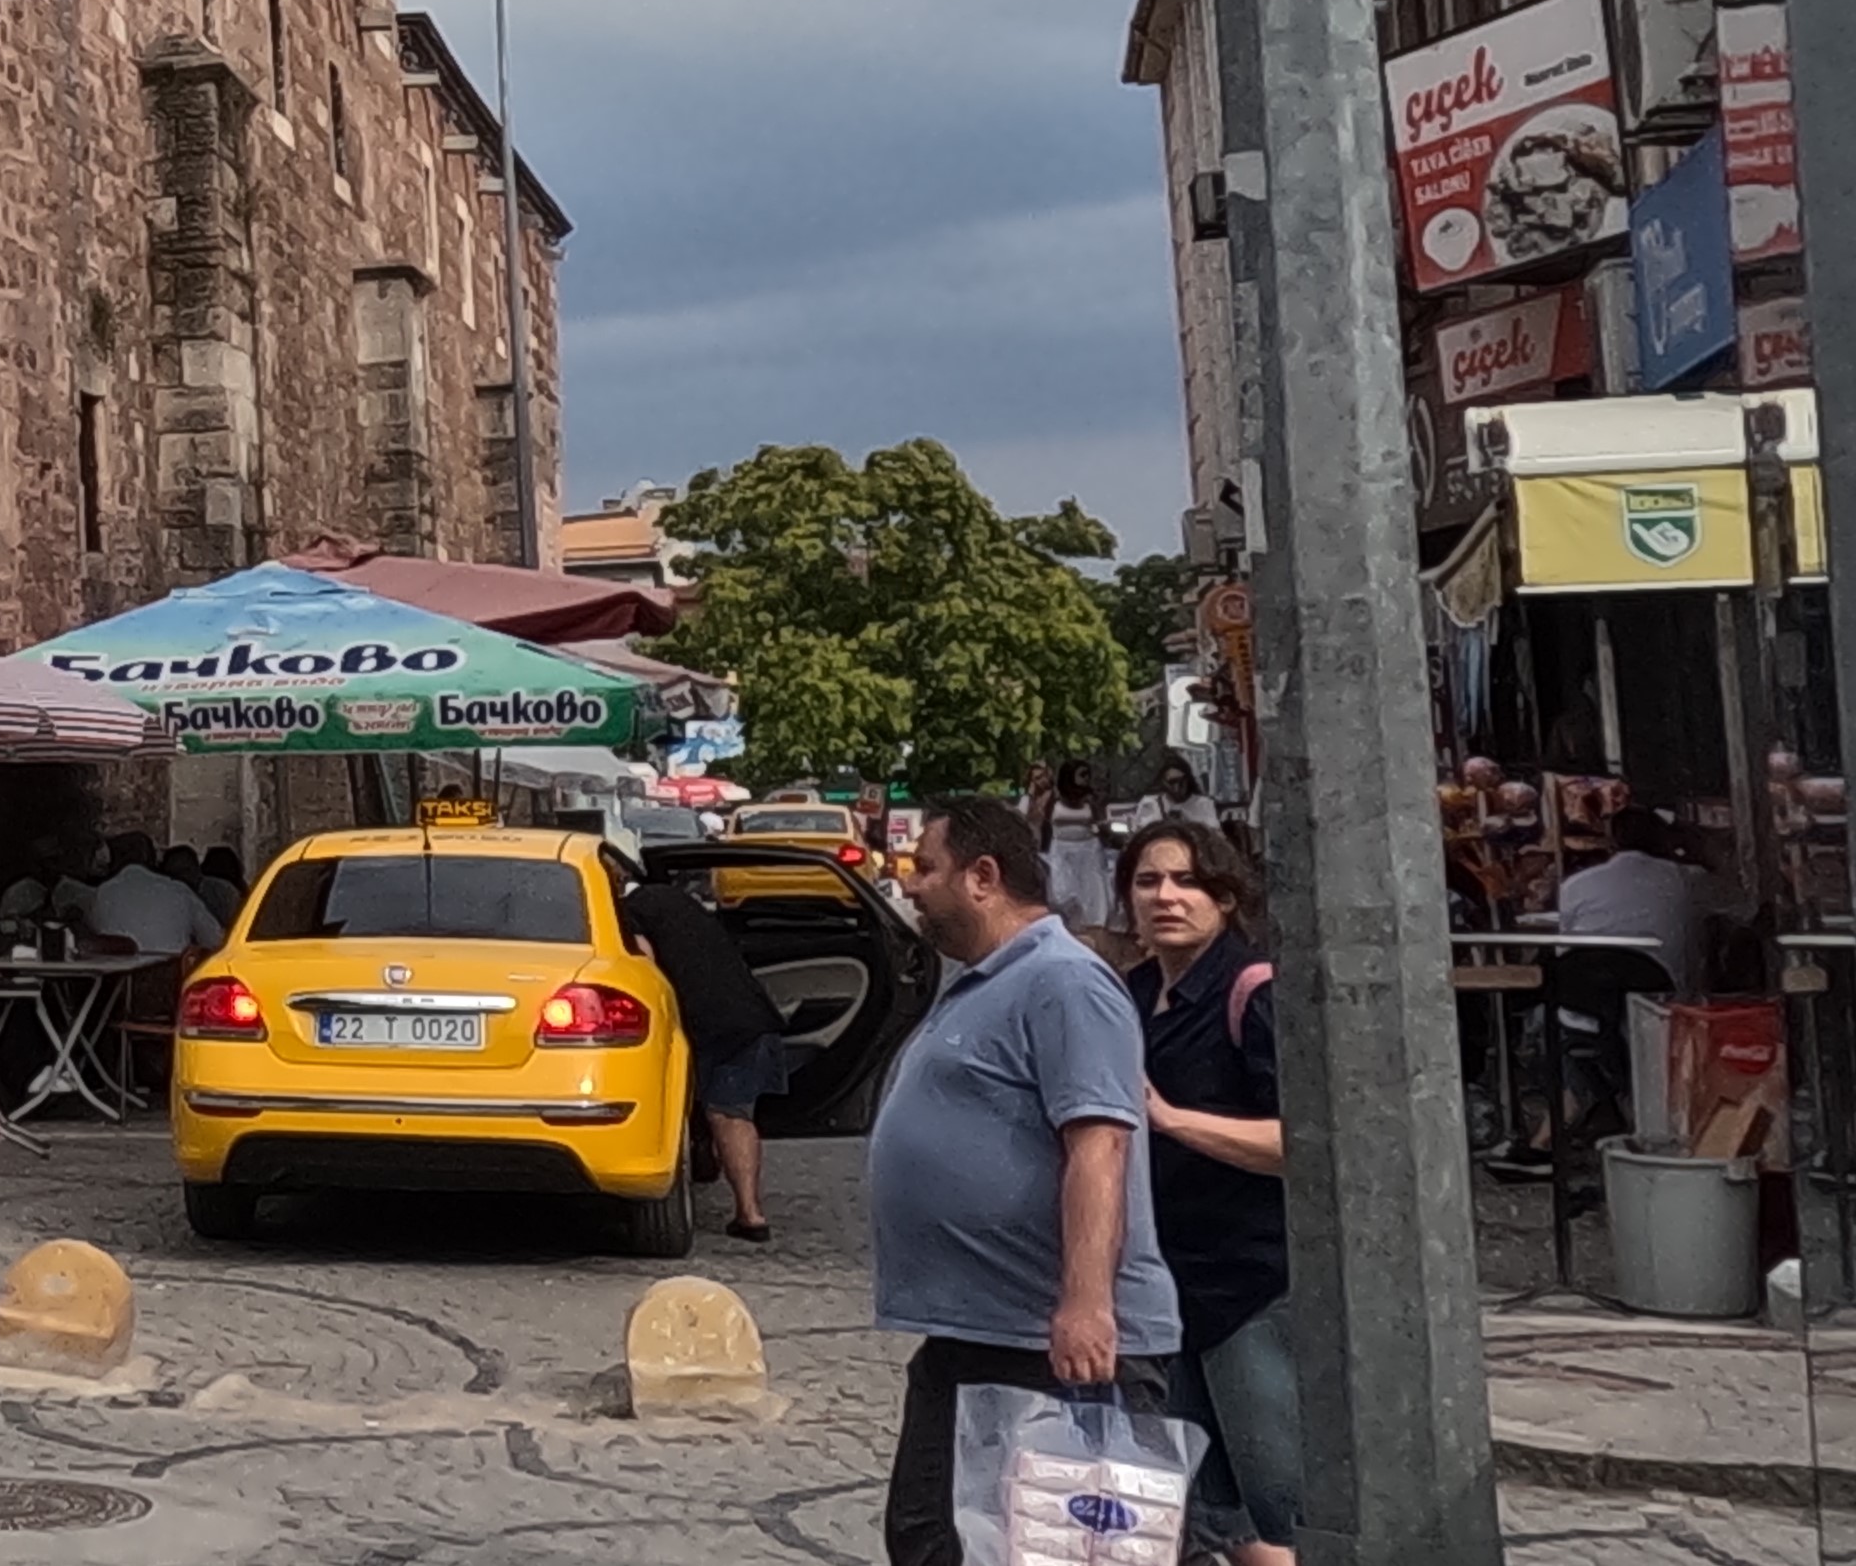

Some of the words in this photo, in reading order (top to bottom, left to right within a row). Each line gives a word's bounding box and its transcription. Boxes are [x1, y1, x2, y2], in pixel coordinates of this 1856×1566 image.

[51, 643, 459, 683] Бачково
[165, 695, 321, 732] Бачково
[439, 689, 602, 727] Бачково
[335, 1016, 364, 1040] 22
[384, 1015, 398, 1040] T
[411, 1017, 475, 1042] 0020
